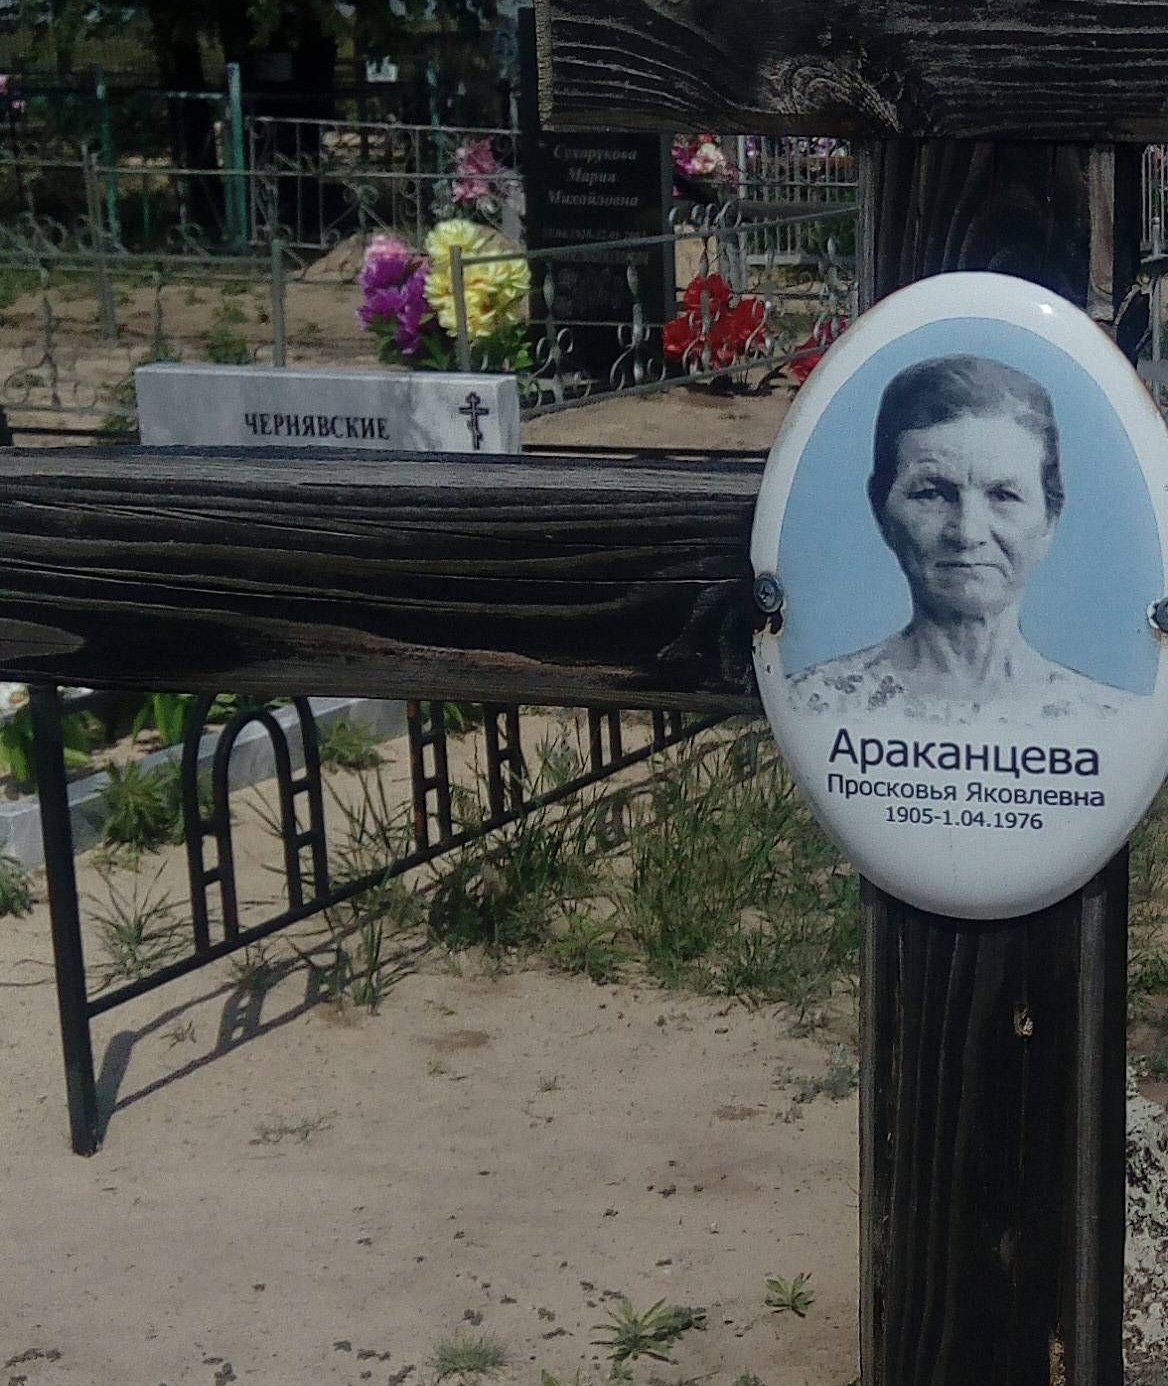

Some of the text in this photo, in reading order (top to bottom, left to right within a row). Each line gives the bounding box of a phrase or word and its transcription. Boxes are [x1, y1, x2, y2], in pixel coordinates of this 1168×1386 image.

[244, 413, 391, 441] ЧЕРНЯВСКИЕ
[828, 728, 1100, 778] Араканцева
[827, 773, 1105, 807] Просковья Яковлевна
[885, 806, 1043, 830] 1905-1.04.1976
